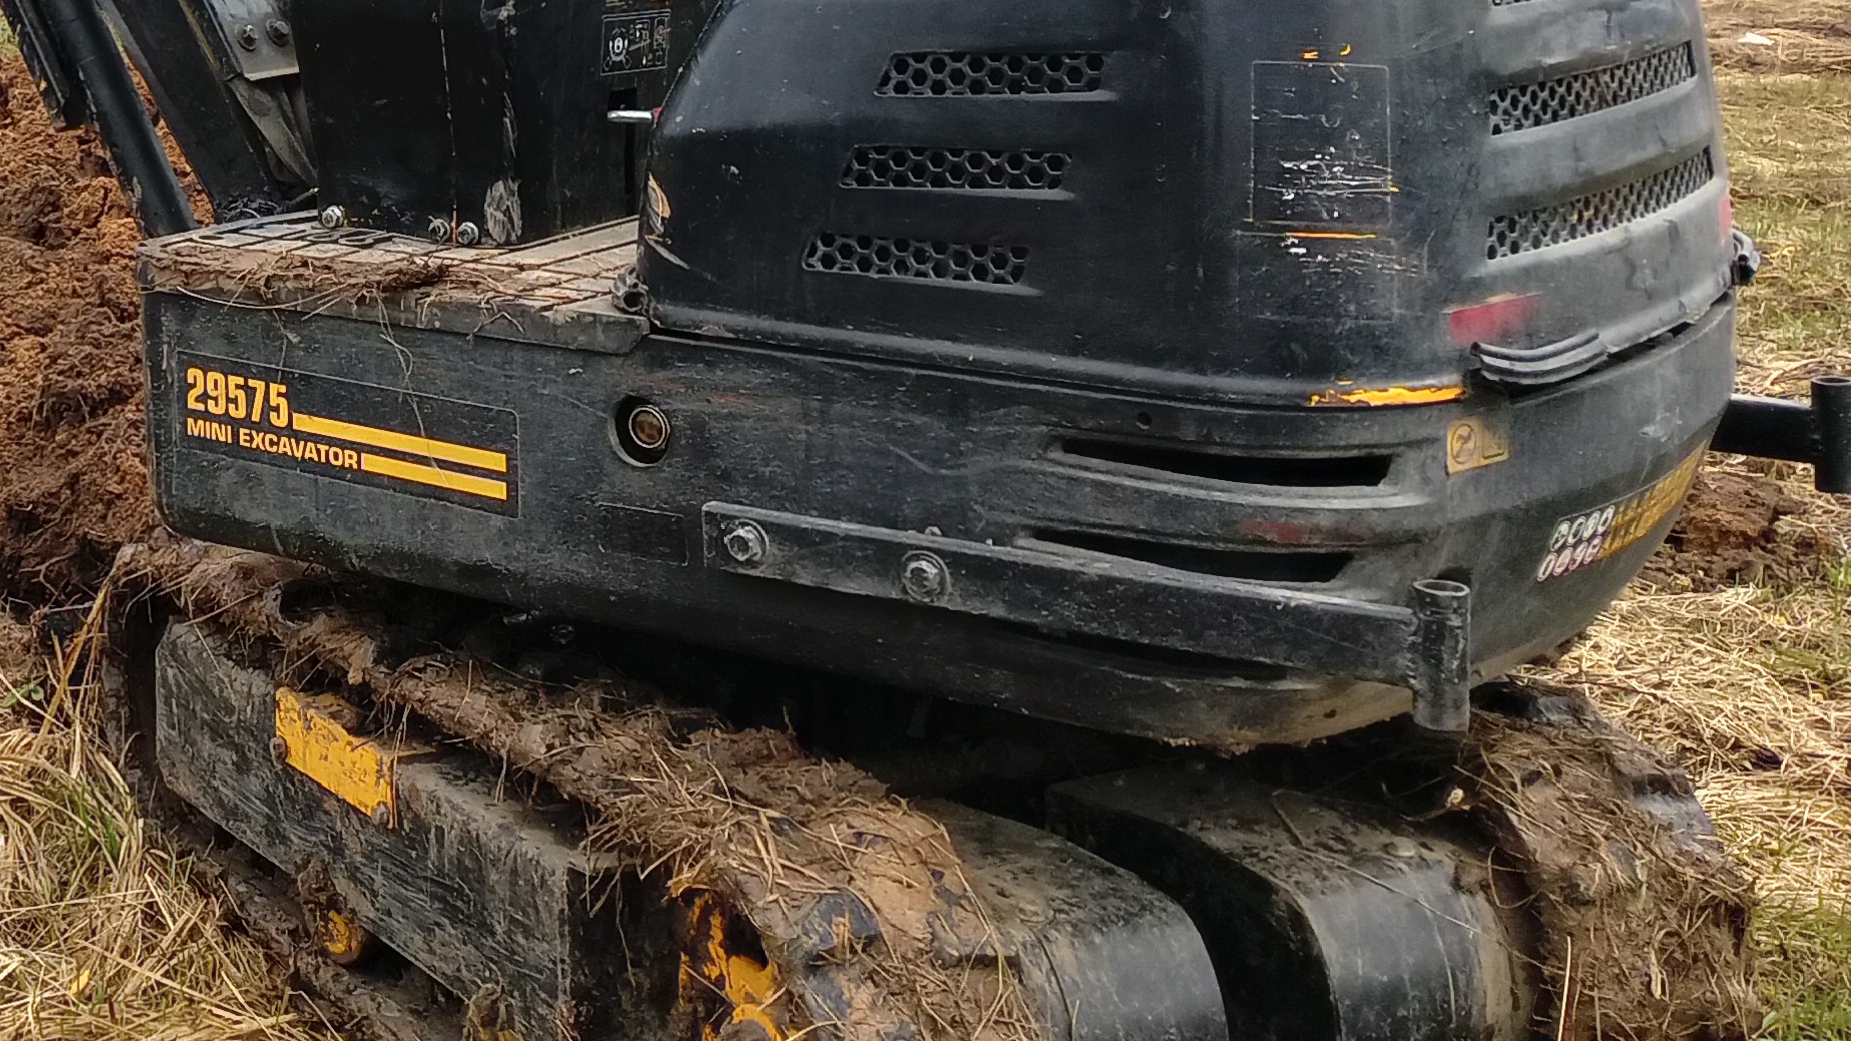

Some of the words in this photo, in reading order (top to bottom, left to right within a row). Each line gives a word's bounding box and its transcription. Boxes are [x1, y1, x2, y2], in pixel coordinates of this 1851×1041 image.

[187, 368, 289, 427] 29575
[187, 417, 233, 444] MINI
[239, 428, 358, 469] EXCAVATOR
